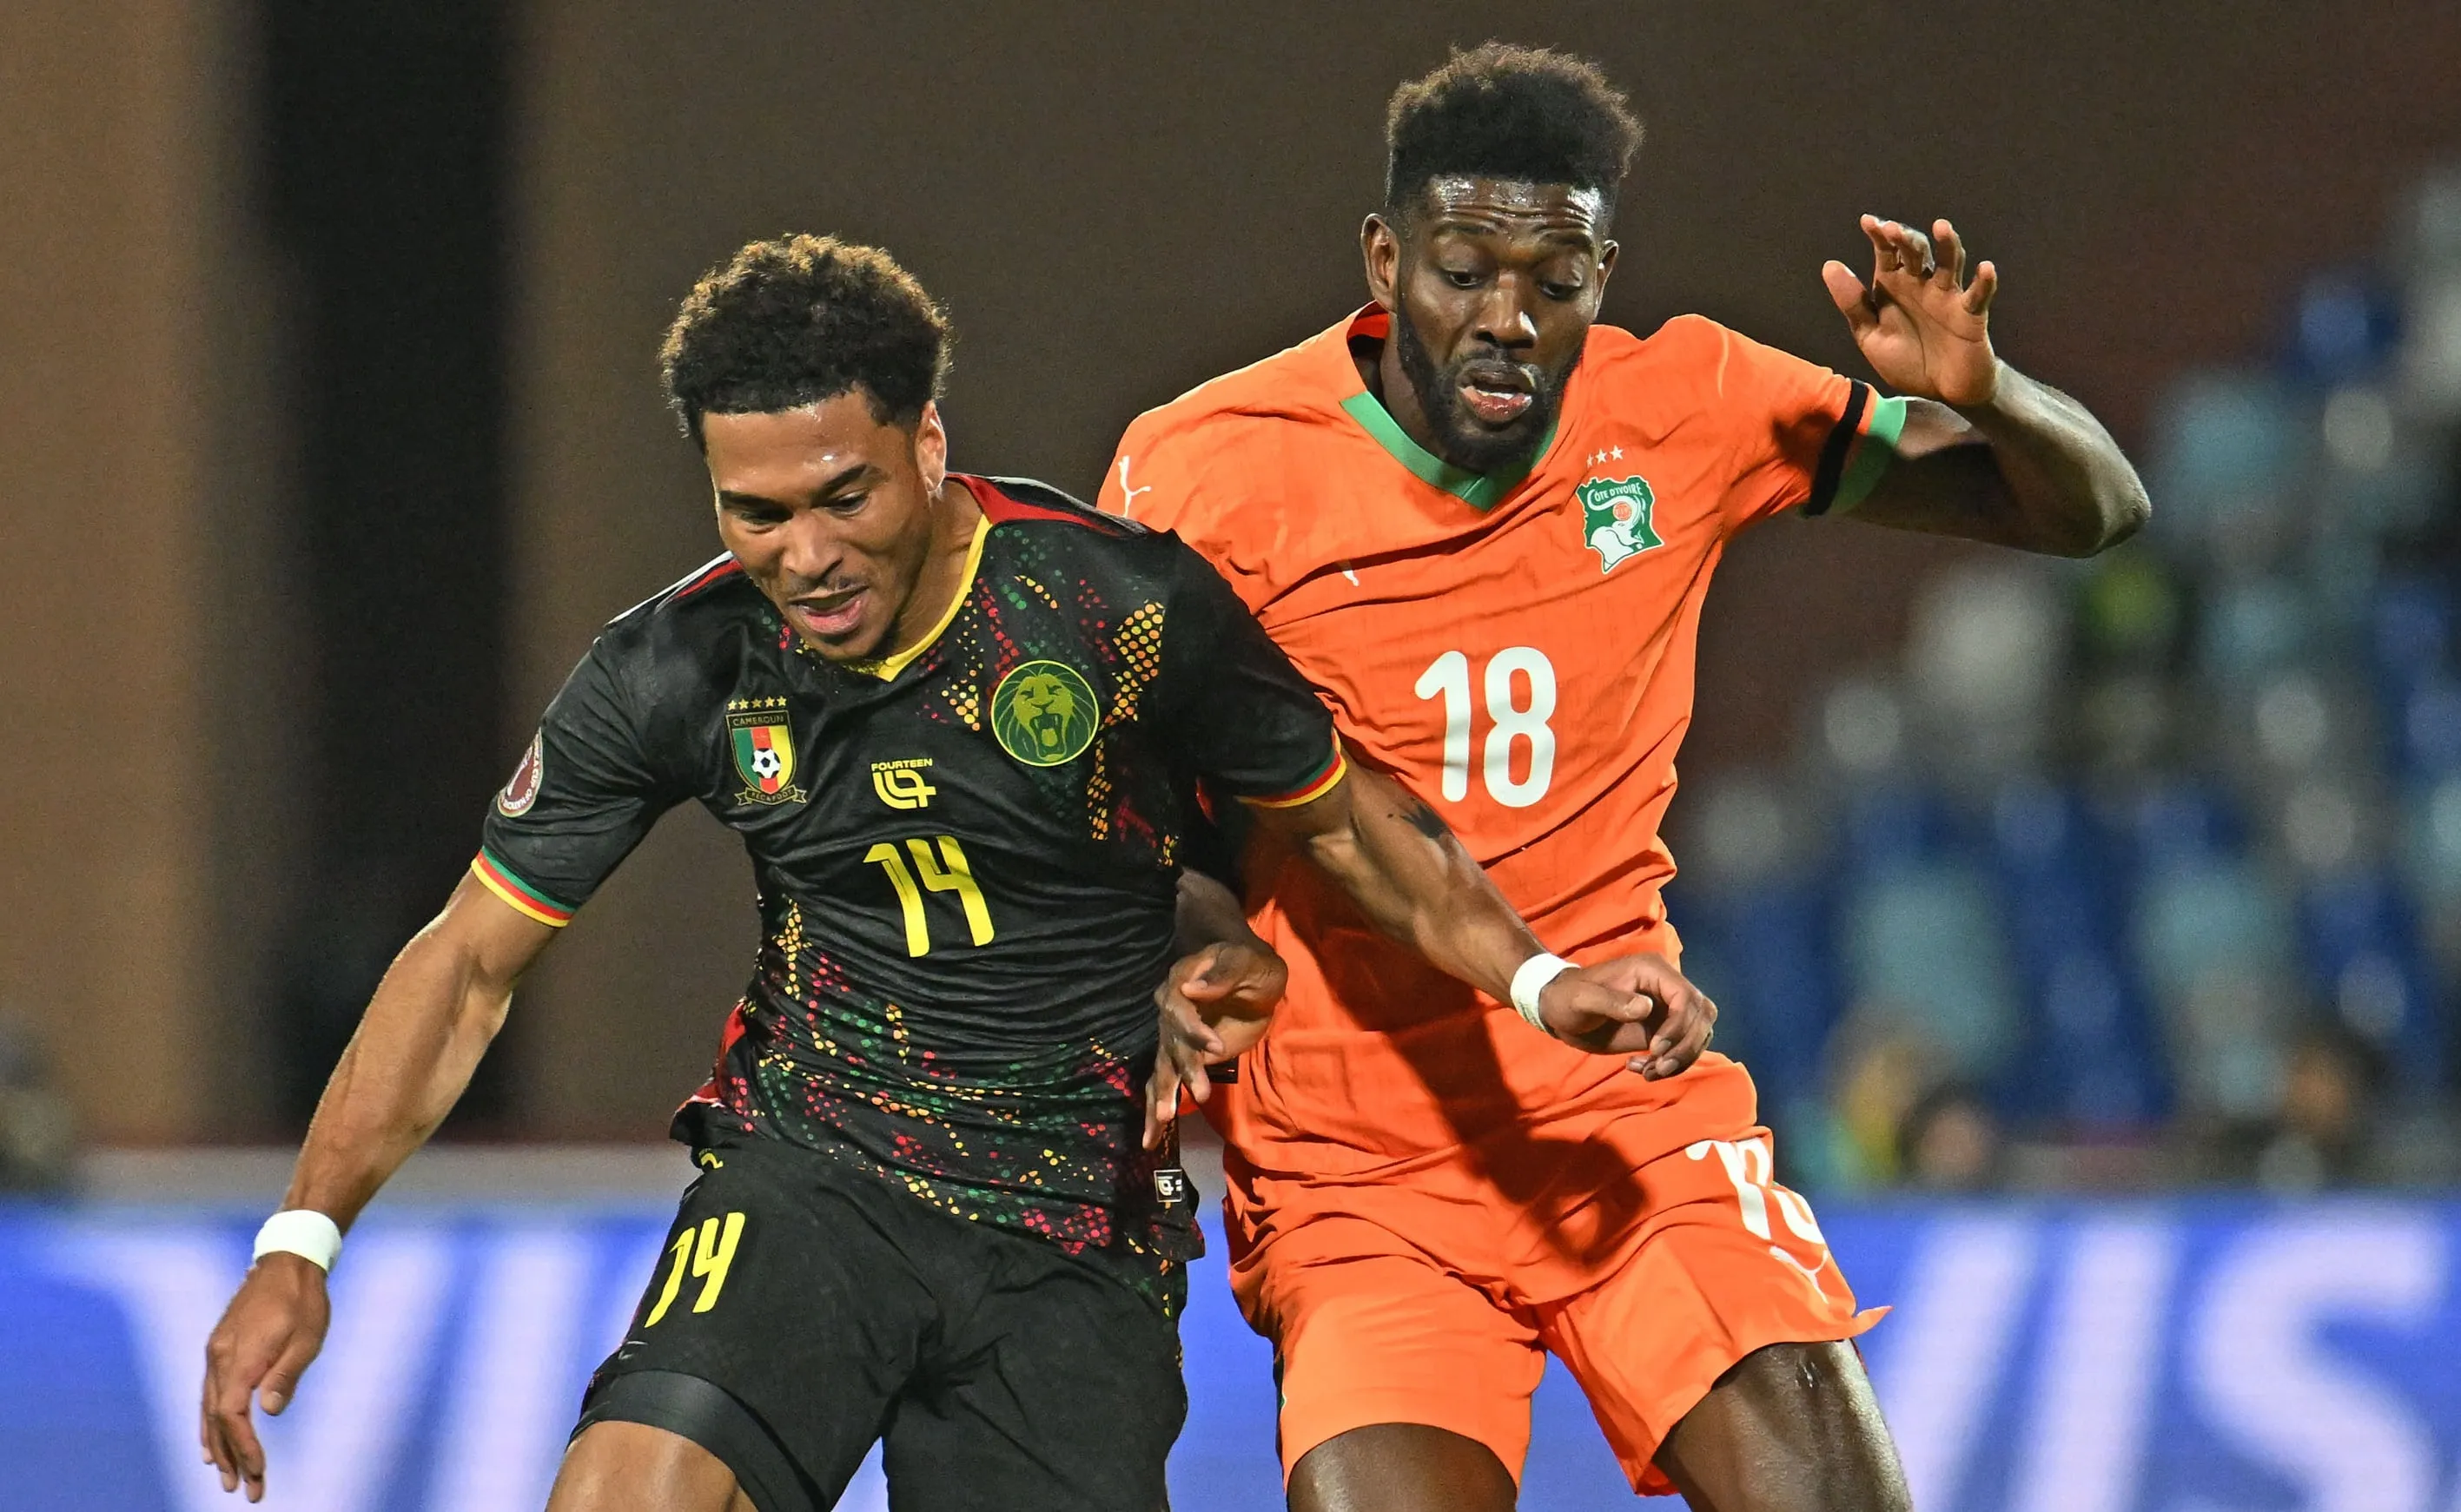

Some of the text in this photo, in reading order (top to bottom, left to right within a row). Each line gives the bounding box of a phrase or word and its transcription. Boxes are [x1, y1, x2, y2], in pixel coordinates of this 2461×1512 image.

[732, 715, 784, 726] CAMEROUN
[870, 757, 933, 772] FOURTEEN
[1414, 646, 1557, 808] 18
[863, 835, 995, 958] 14
[644, 1212, 746, 1329] 14
[52, 1223, 665, 1512] VI
